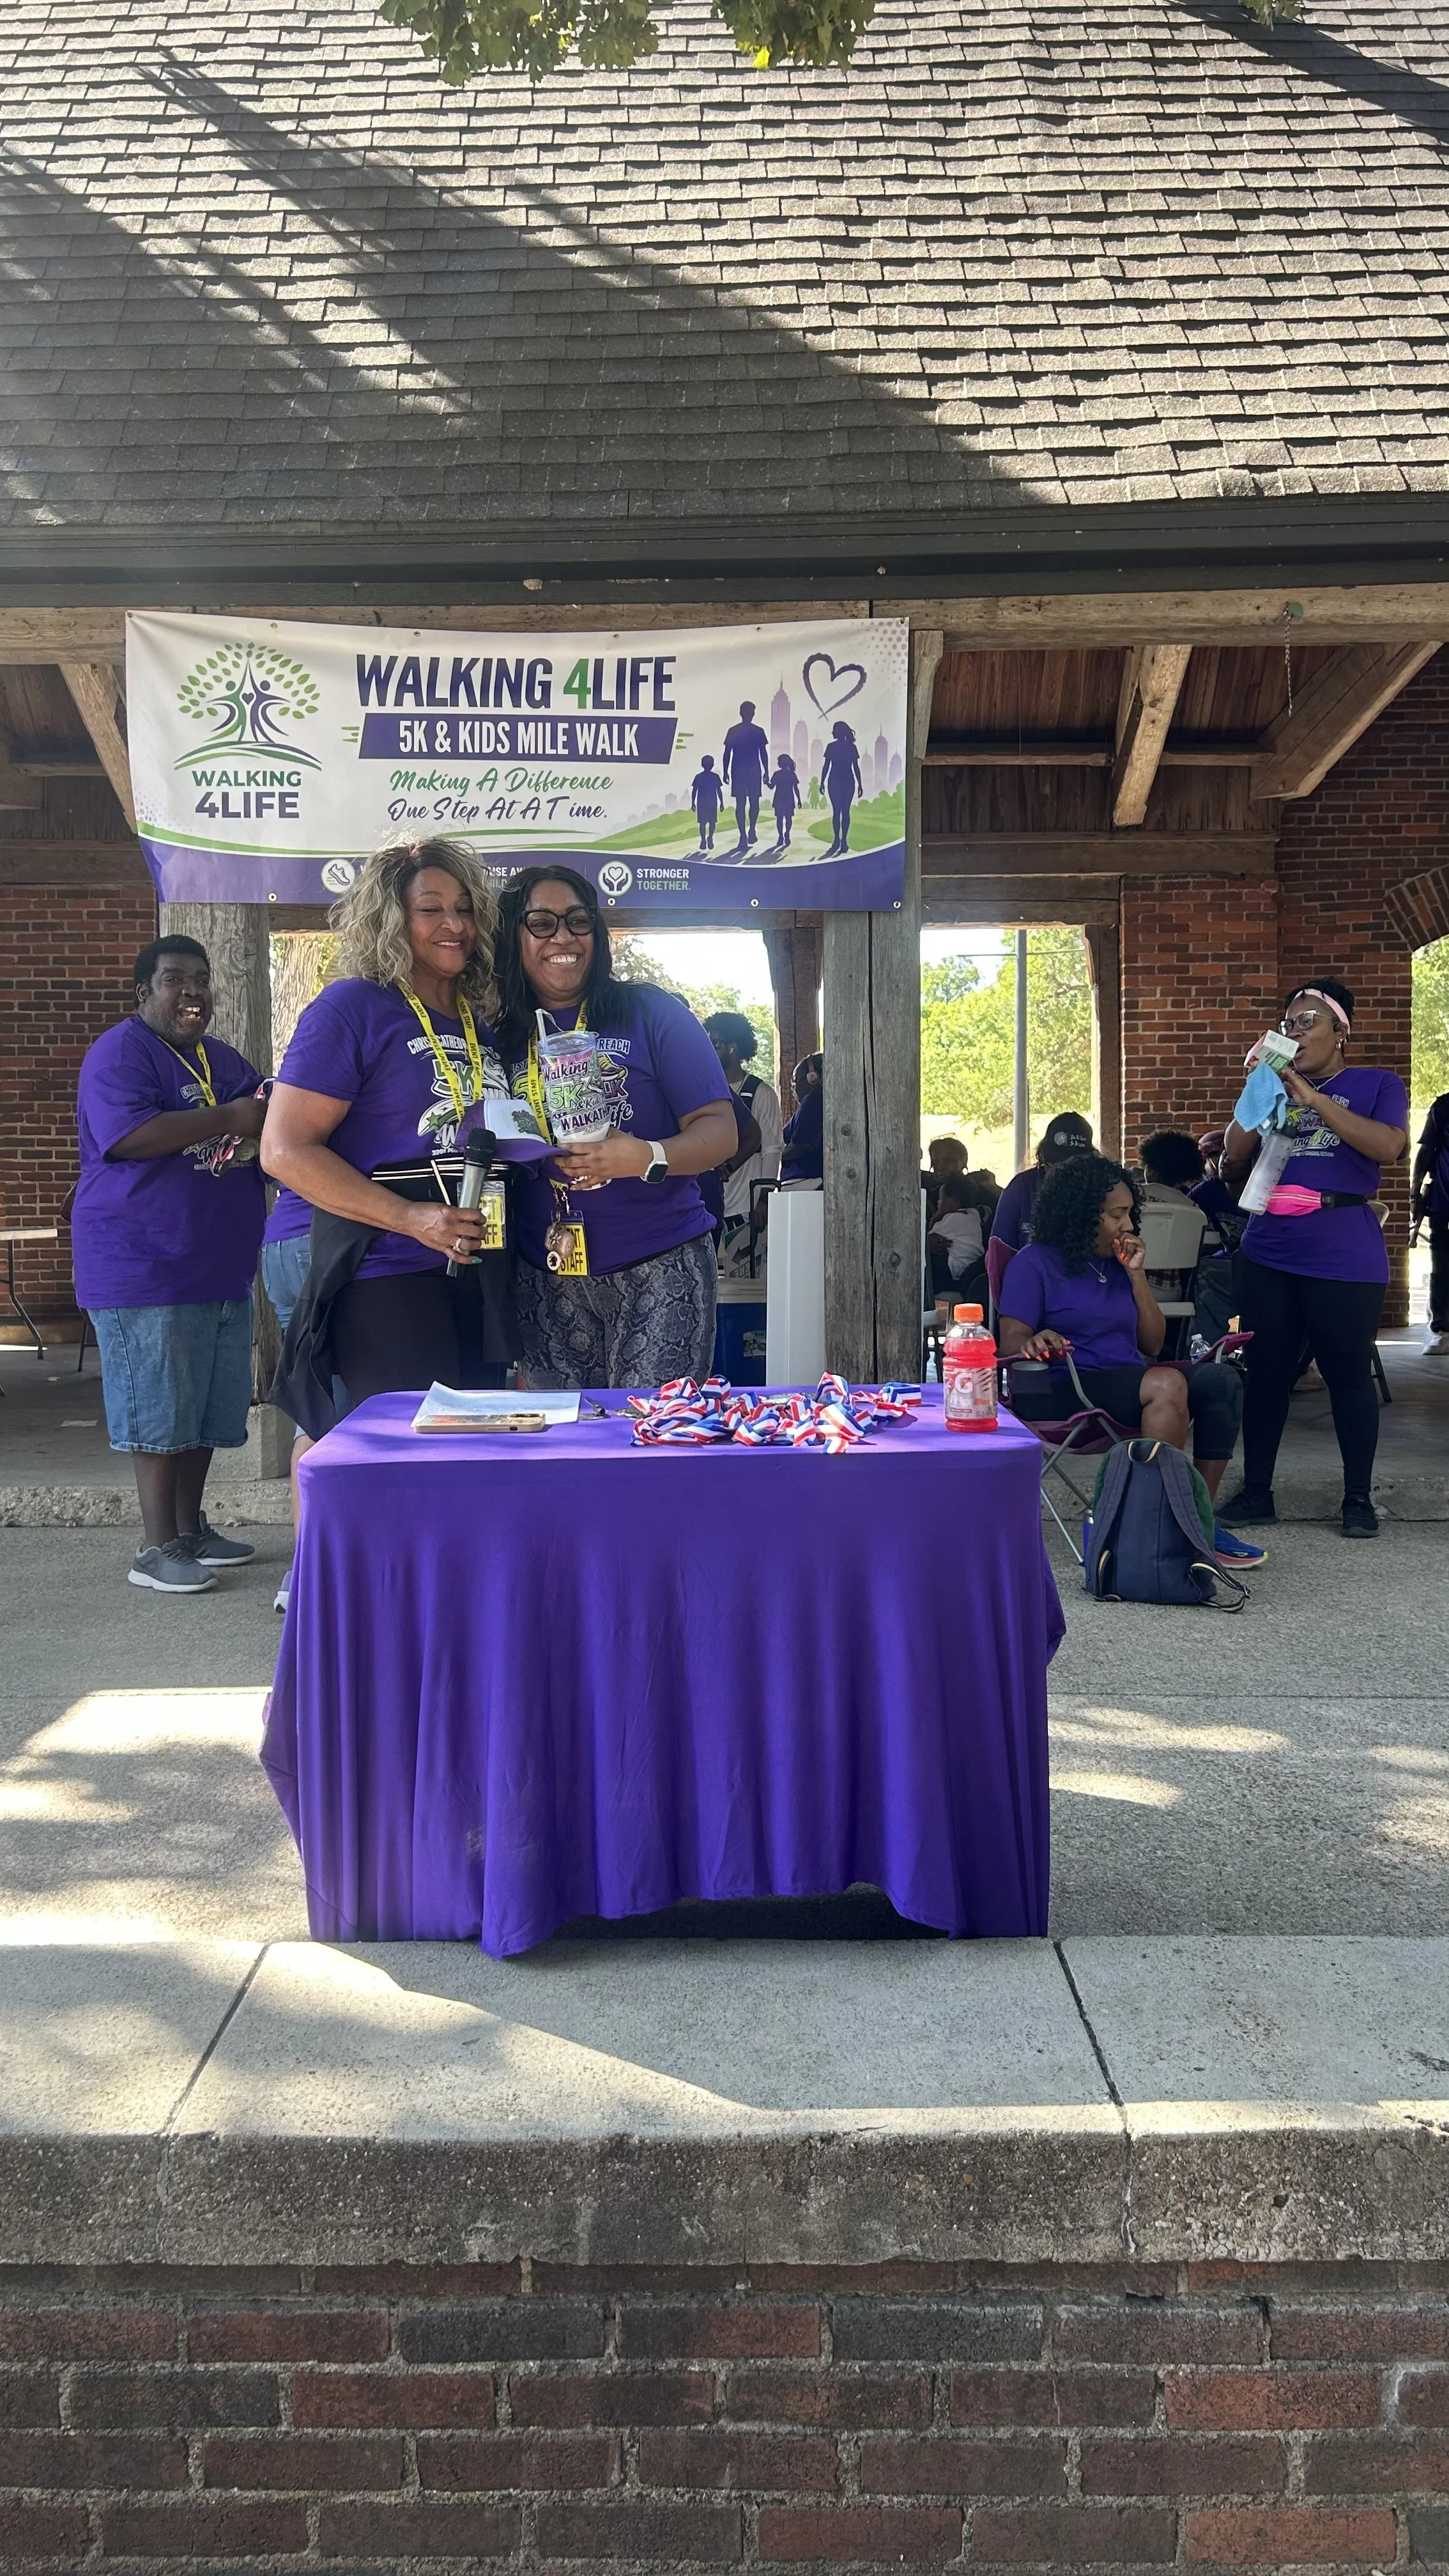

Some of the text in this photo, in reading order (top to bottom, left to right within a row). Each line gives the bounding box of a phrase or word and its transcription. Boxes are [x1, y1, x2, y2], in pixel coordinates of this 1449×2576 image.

[356, 654, 677, 711] WALKING 4LIFE
[399, 719, 640, 756] 5K & KIDS MILE WALK
[192, 770, 302, 786] WALKING
[390, 767, 613, 798] Making A Difference
[195, 791, 300, 818] 4LIFE
[387, 798, 429, 822] One
[432, 796, 479, 824] Step
[485, 797, 516, 822] At
[520, 797, 542, 821] A
[636, 868, 689, 879] STRONGER
[636, 880, 691, 891] TOGETHER.
[407, 1036, 433, 1055] CHRIS
[544, 1059, 589, 1082] Walking
[550, 1082, 585, 1110] 5K
[533, 1100, 544, 1119] EVENT
[560, 1252, 583, 1272] STAFF
[954, 1372, 973, 1393] G
